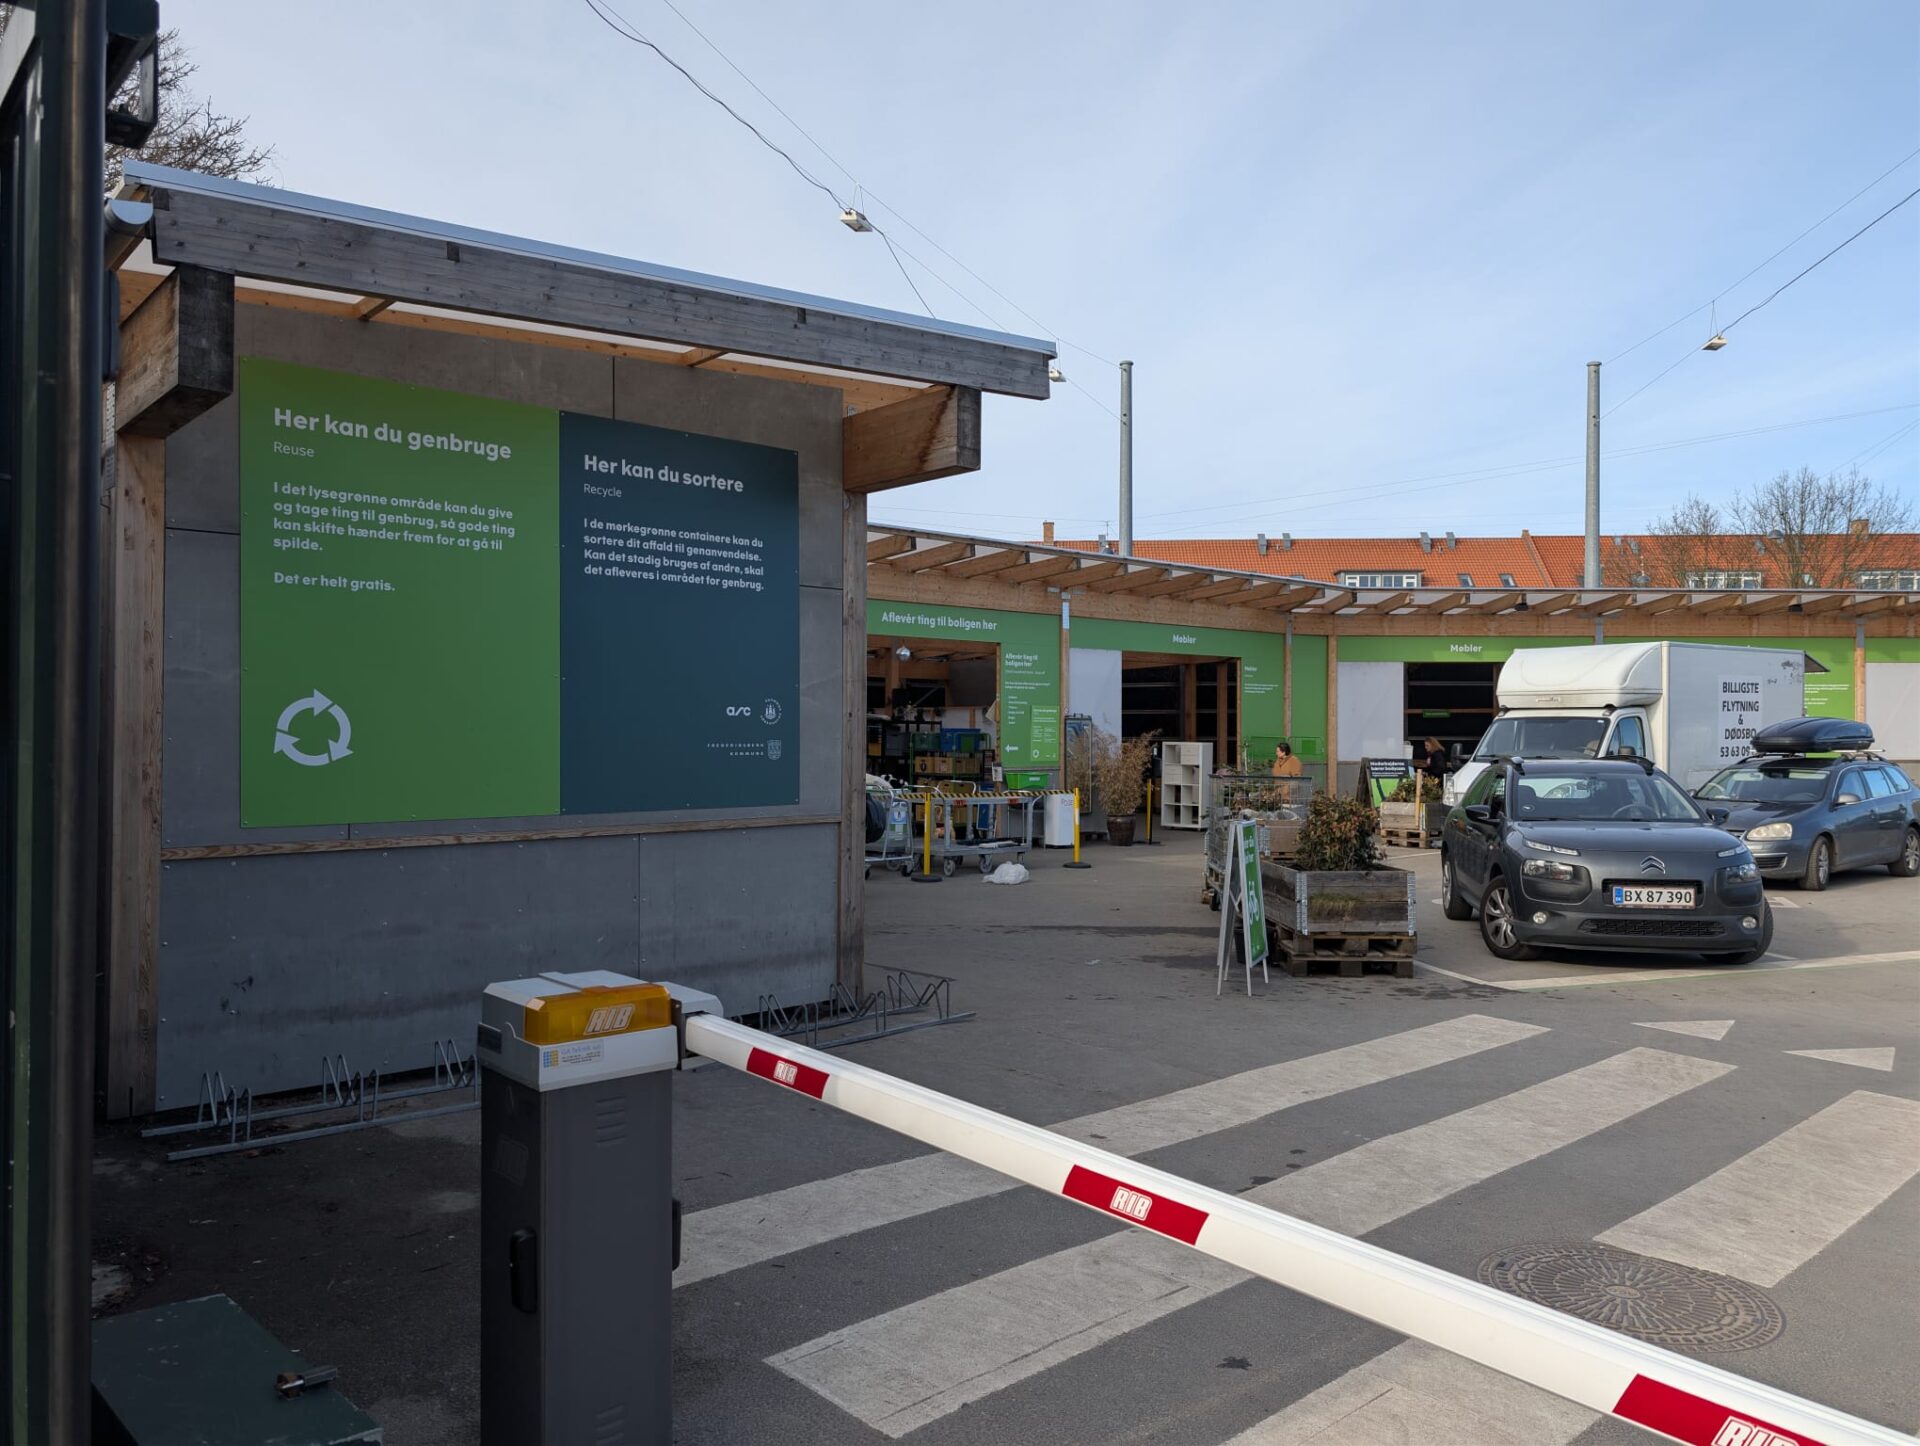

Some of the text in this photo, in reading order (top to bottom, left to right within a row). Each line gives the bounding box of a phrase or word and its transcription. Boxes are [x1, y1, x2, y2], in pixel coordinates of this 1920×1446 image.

[274, 407, 512, 462] Her kan du genbruge
[273, 441, 315, 457] Reuse
[584, 454, 744, 493] Her kan du sortere
[273, 482, 513, 520] I det lysegrønne område kan du give
[583, 483, 622, 498] Recycle
[273, 502, 515, 538] og tage ting til genbrug, så gode ting
[273, 518, 503, 551] kan skifte hænder frem for at gå til
[273, 536, 323, 552] spilde.
[584, 518, 763, 548] I de mørkegrønne containere kan du
[583, 534, 762, 562] sortere dit affald til genanvendelse.
[584, 549, 764, 576] Kan det stadig bruges af andre, skal
[274, 572, 396, 592] Det er helt gratis.
[584, 564, 765, 592] det afleveres i området for genbrug.
[918, 614, 936, 628] ting
[937, 616, 946, 626] til
[948, 617, 981, 630] boligen
[982, 619, 998, 630] her
[1723, 682, 1759, 693] BILLIGSTE
[1722, 701, 1759, 712] FLYTNING
[1738, 714, 1744, 725] &
[1720, 746, 1750, 757] 53 63 09
[1625, 891, 1642, 902] BX
[1647, 891, 1663, 903] 87
[1667, 891, 1692, 903] 390
[585, 1005, 634, 1034] RIB
[775, 1061, 797, 1084] RIB
[1111, 1187, 1152, 1220] RIB
